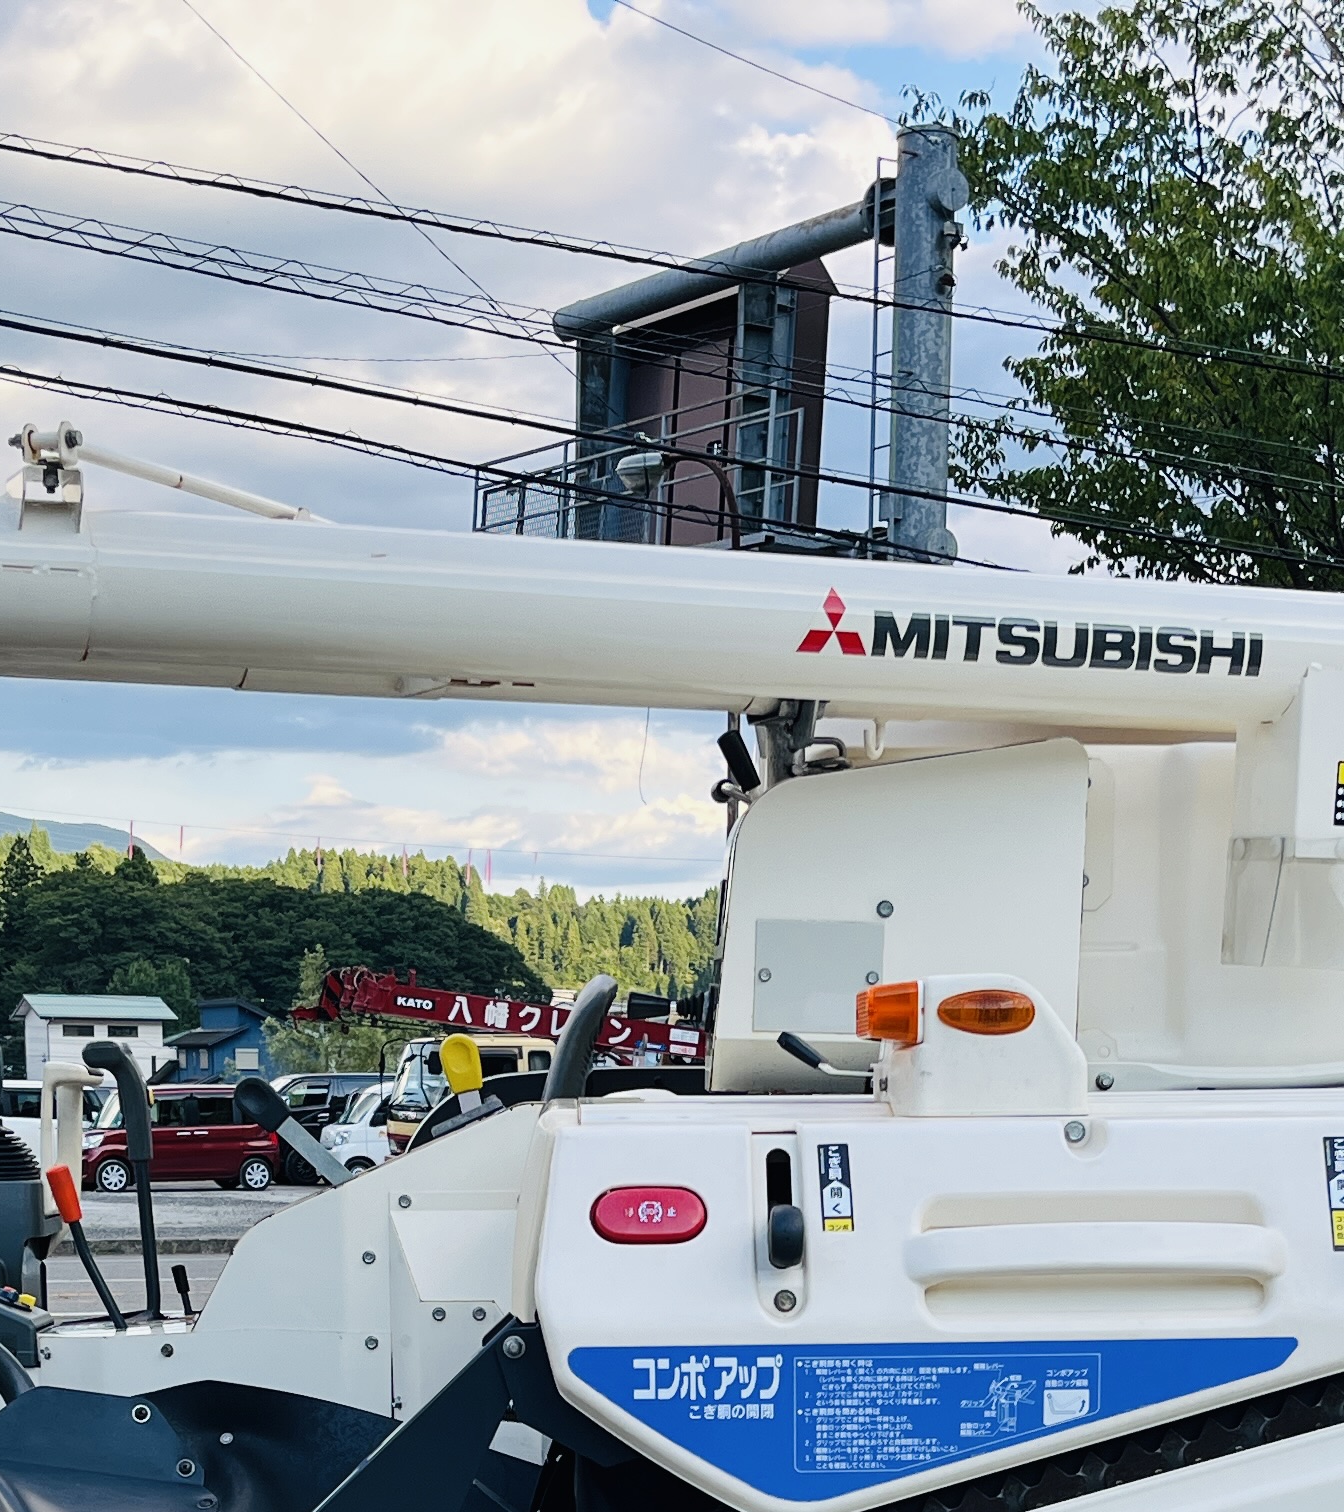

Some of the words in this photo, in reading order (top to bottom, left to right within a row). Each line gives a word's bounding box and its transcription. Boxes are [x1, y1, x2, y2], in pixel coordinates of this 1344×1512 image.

[870, 609, 1263, 679] MITSUBISHI
[395, 995, 434, 1011] KATO
[447, 995, 632, 1045] 八幡クレン
[830, 1186, 843, 1215] 開く
[688, 1403, 775, 1421] こぎ胴の開閉
